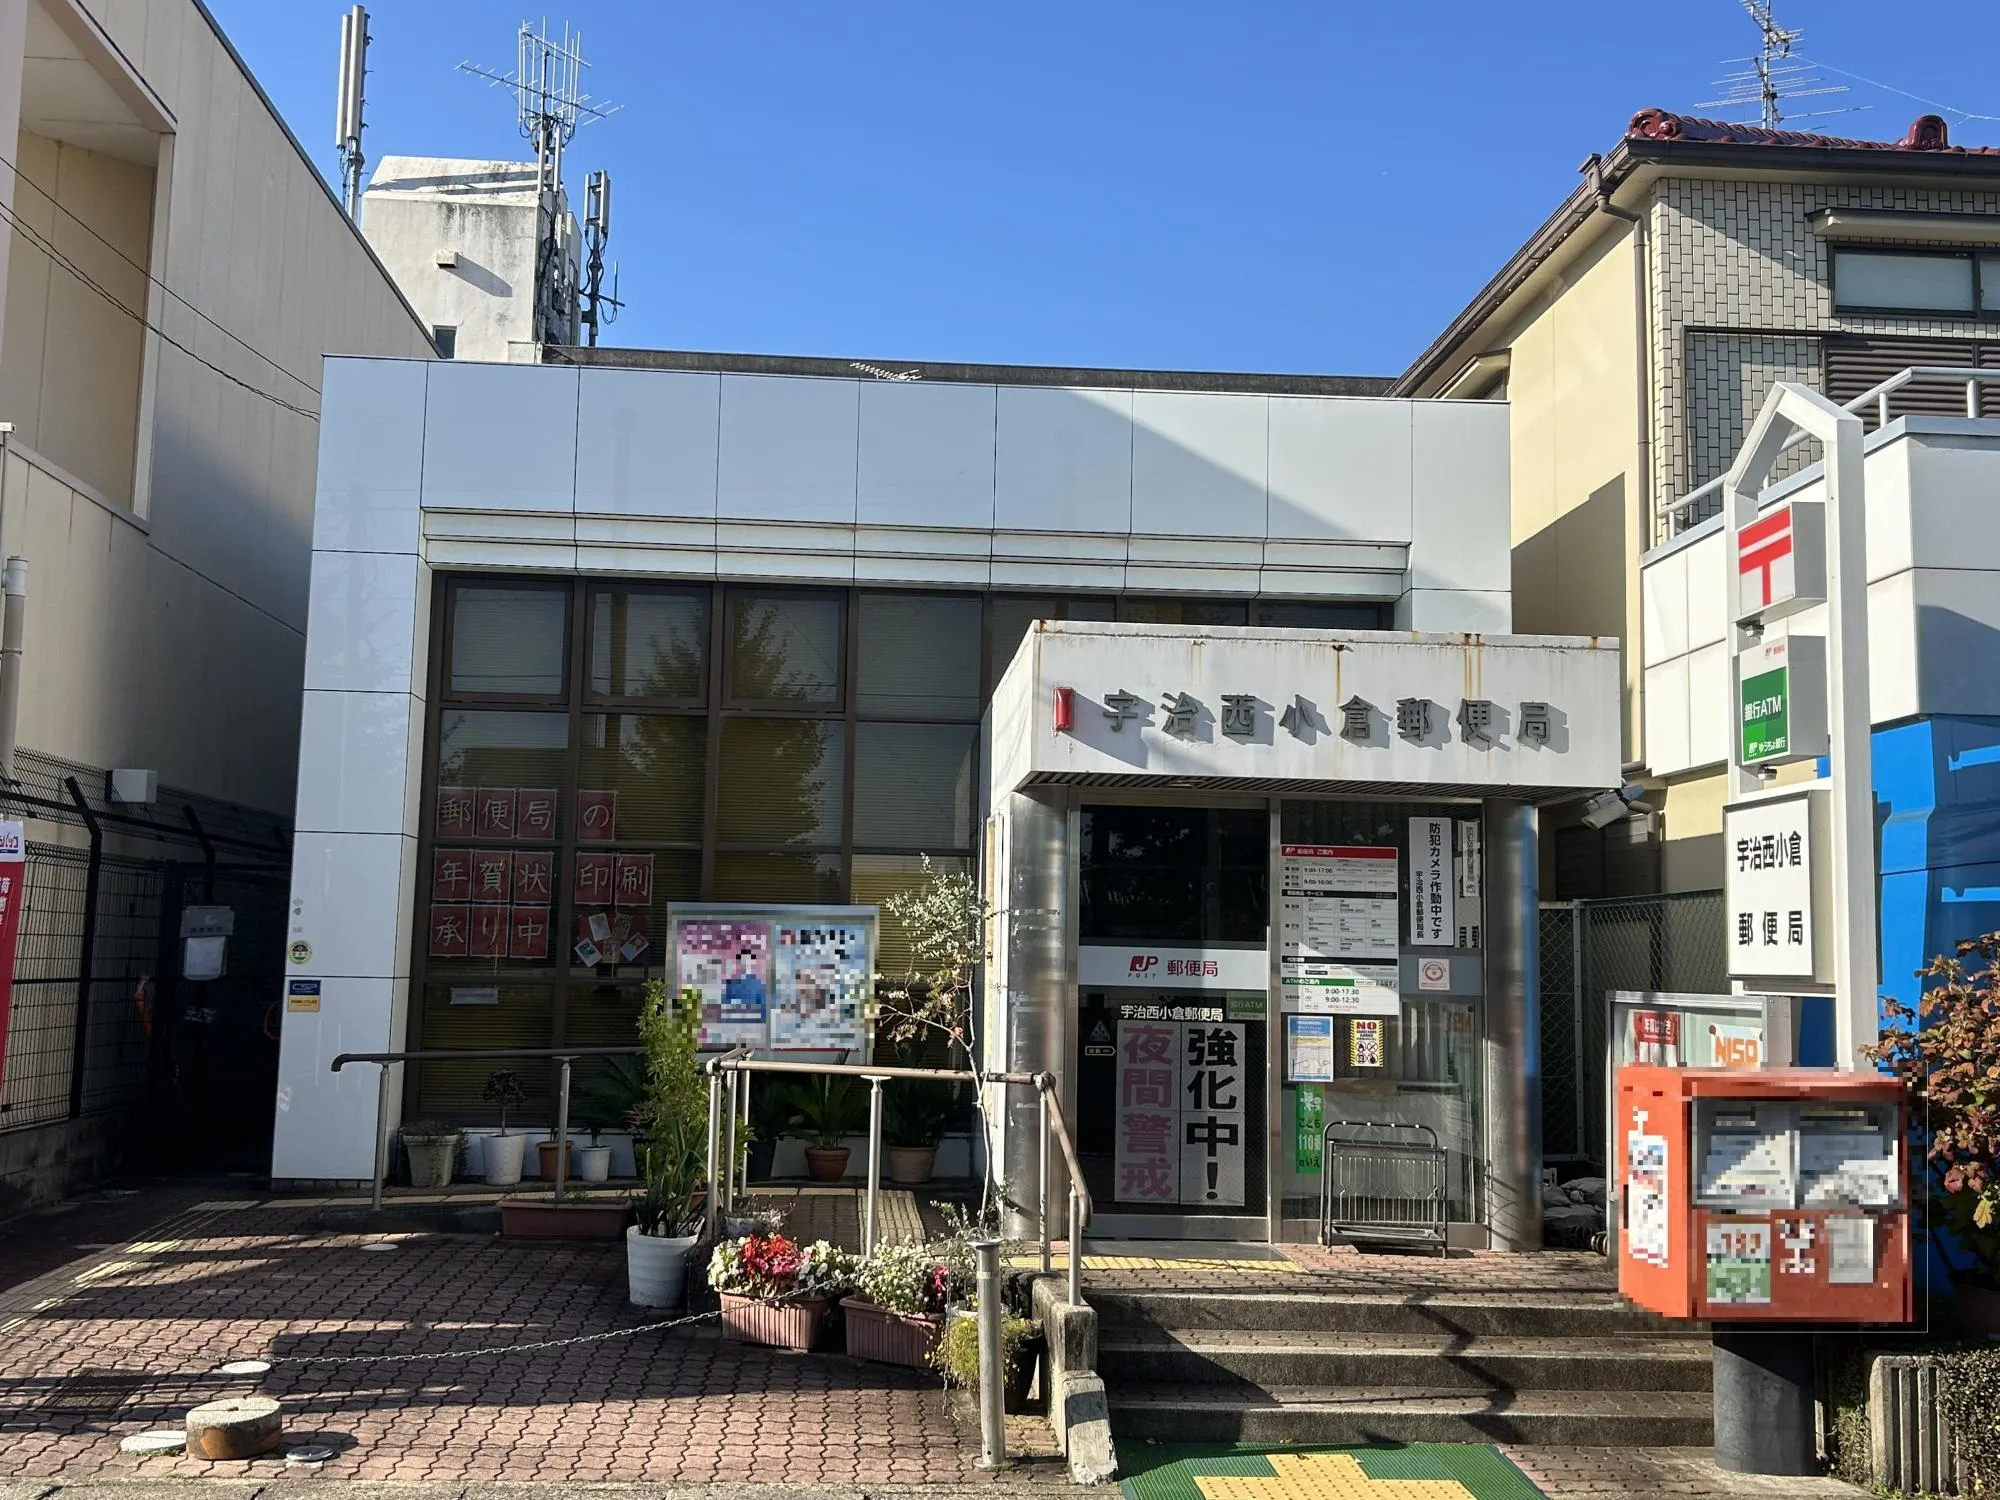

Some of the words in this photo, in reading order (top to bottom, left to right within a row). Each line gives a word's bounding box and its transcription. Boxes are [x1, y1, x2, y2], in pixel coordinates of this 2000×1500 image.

[1101, 688, 1552, 744] 宇治西小倉郵便局
[1744, 694, 1783, 723] 銀行ATM
[1737, 829, 1802, 872] 宇治西小倉
[1429, 822, 1442, 939] 防犯カメラ作動中です
[434, 915, 545, 948] 承り中
[1738, 910, 1804, 947] 郵便局
[1167, 959, 1219, 978] 郵便局
[1120, 1005, 1224, 1022] 宇治西小倉郵便局
[1120, 1024, 1173, 1200] 夜間警戒
[1186, 1028, 1239, 1200] 強化中！
